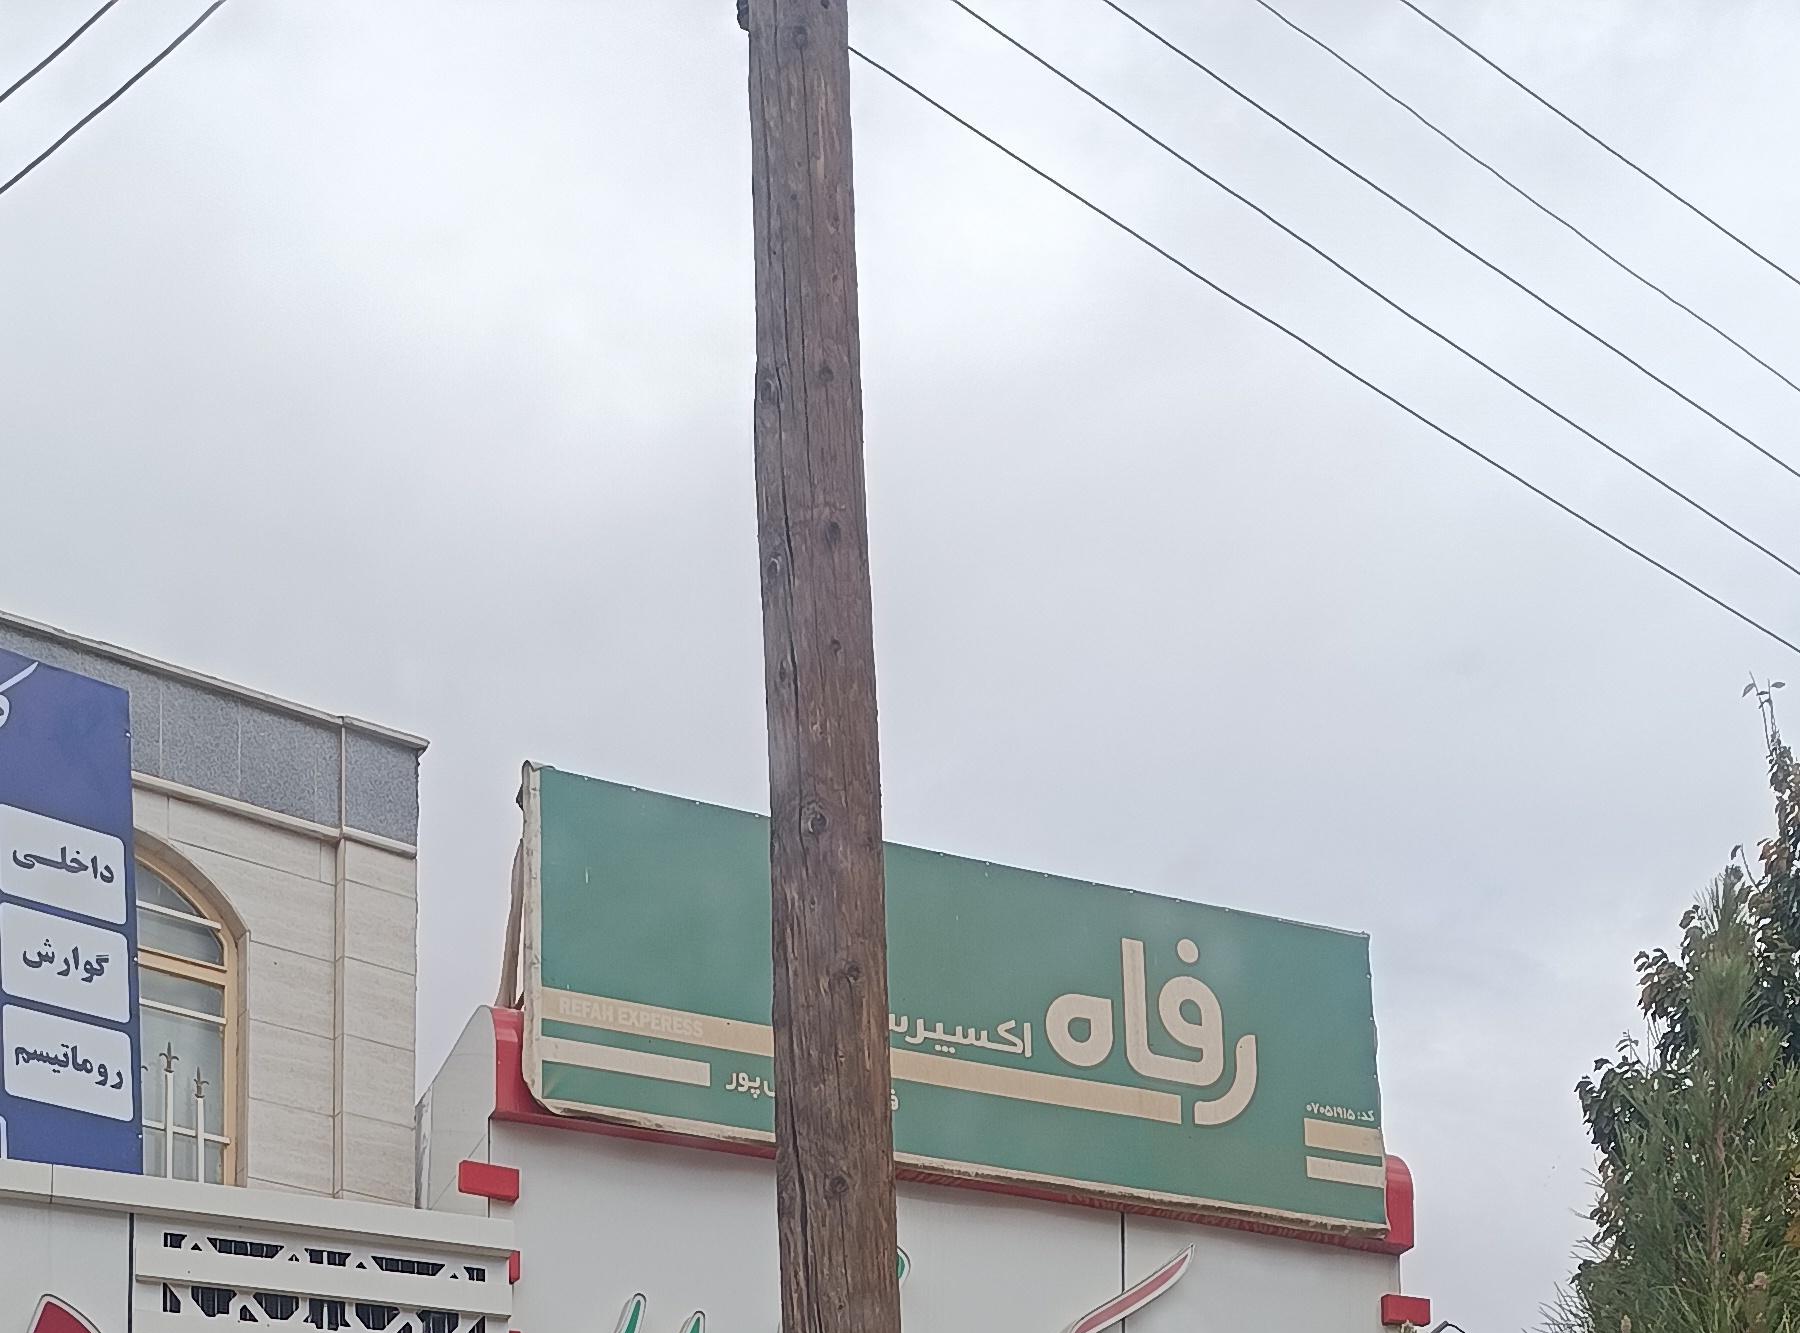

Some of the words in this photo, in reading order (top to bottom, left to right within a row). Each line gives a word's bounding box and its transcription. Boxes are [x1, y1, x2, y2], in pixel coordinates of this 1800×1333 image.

[12, 846, 115, 884] داخلی
[22, 938, 110, 983] گوارش
[559, 997, 614, 1024] REFAH
[618, 1006, 704, 1038] EXPERESS
[1045, 937, 1258, 1126] رفاه
[14, 1043, 124, 1090] روماتیسم
